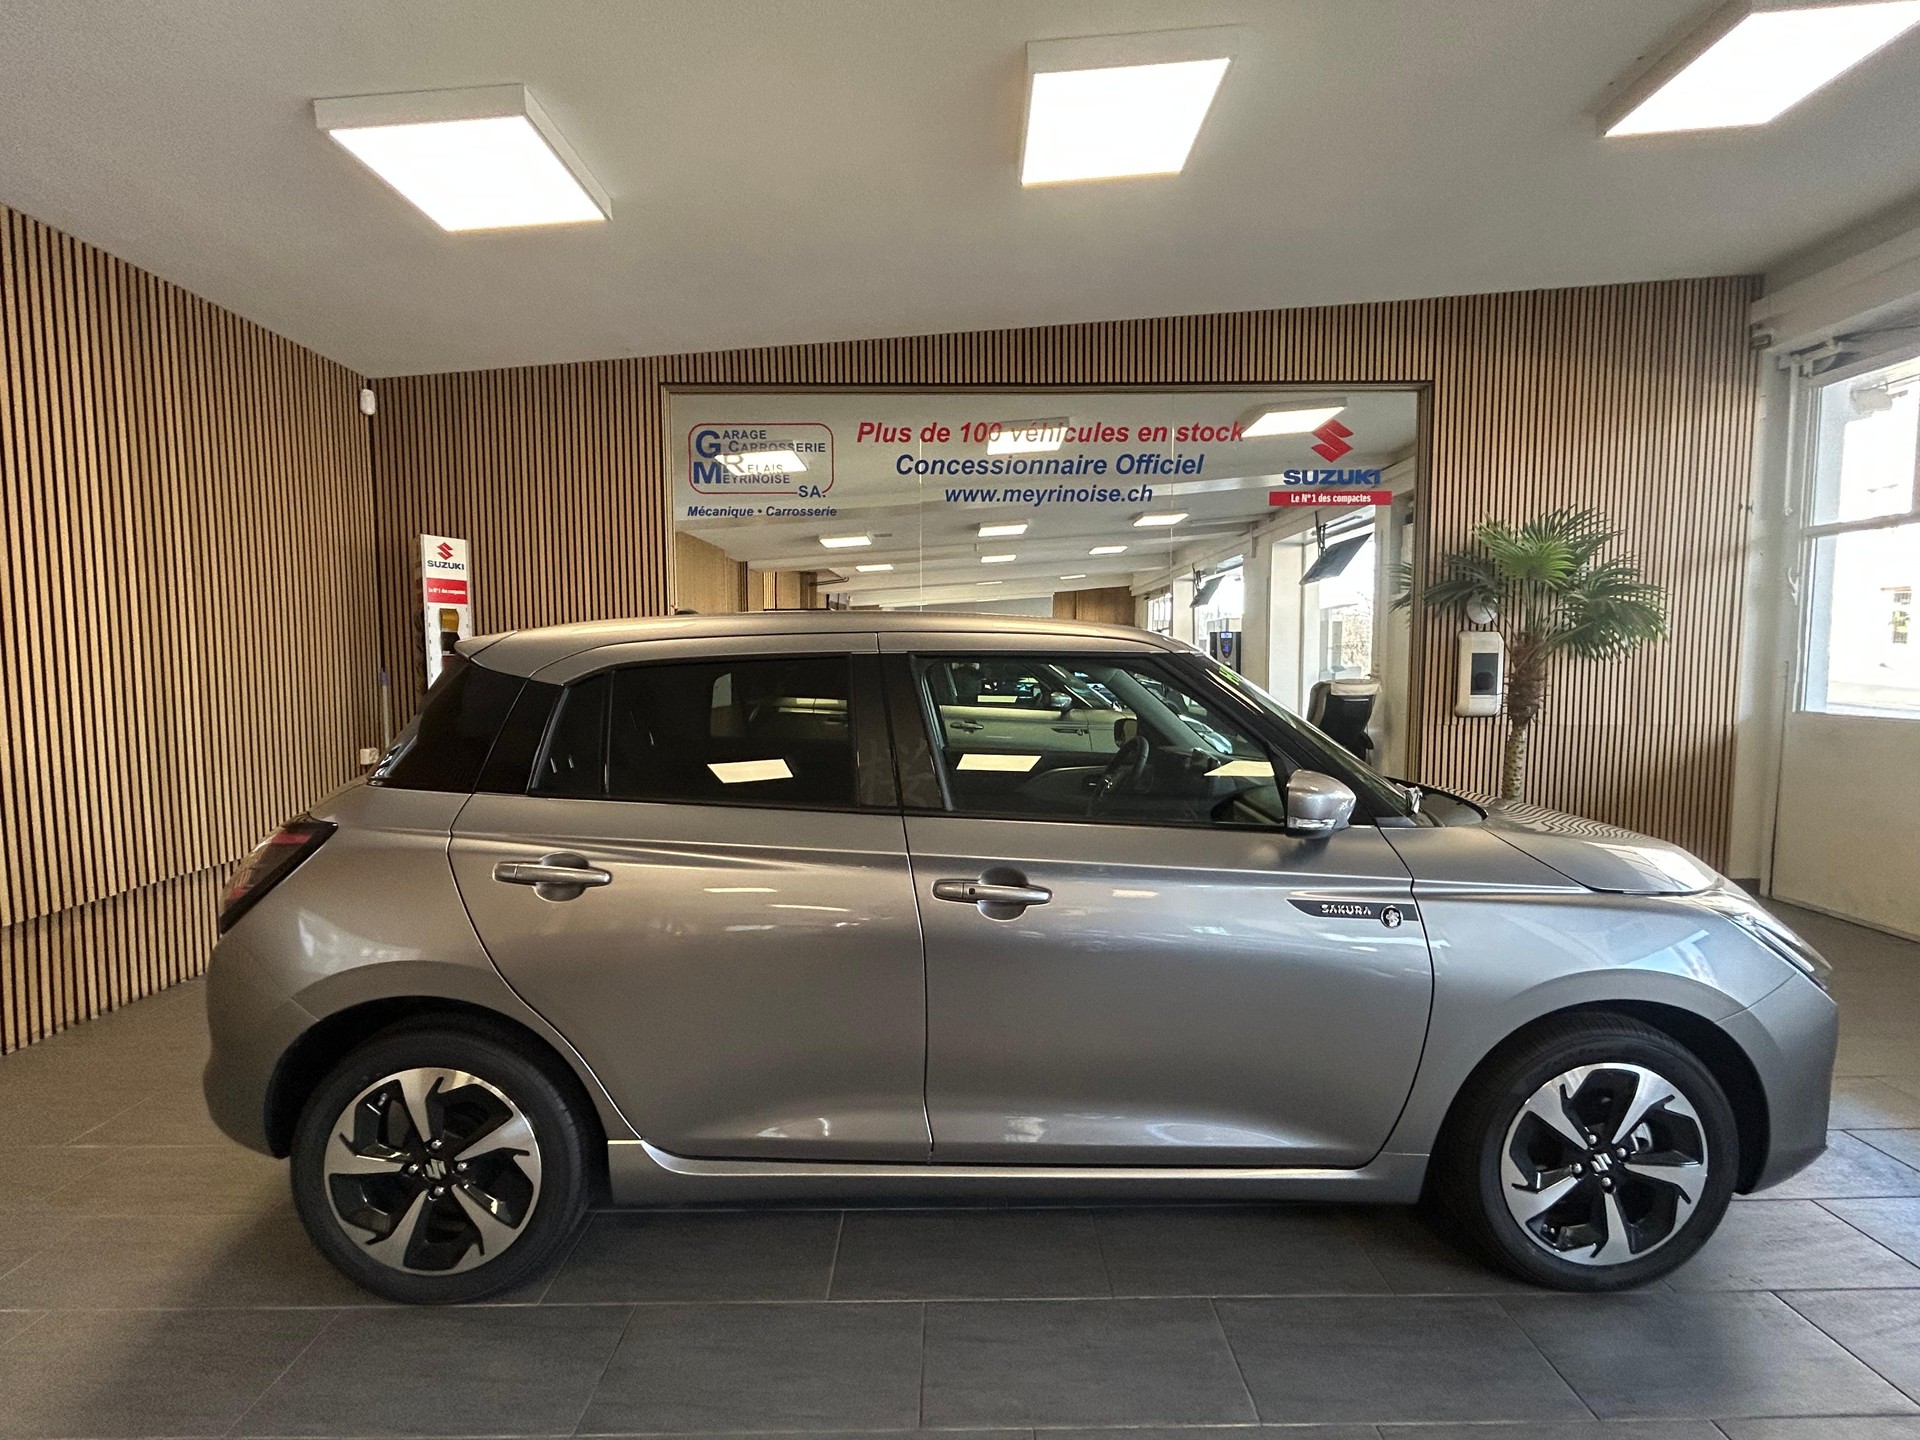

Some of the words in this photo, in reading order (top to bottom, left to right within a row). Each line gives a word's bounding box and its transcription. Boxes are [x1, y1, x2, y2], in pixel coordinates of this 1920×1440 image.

[857, 422, 912, 443] Plus
[920, 422, 950, 443] de
[960, 422, 1003, 443] 100
[1011, 421, 1130, 443] véhicules
[1138, 426, 1168, 443] en
[1175, 422, 1244, 443] stock
[695, 430, 767, 459] GARAGE
[728, 440, 826, 453] CARROSSERIE
[693, 461, 791, 484] MEYRINOISE
[722, 452, 784, 474] RELAIS
[896, 454, 1107, 475] Concessionnaire
[1116, 454, 1205, 475] Officiel
[1283, 469, 1381, 486] SUZUKI
[945, 485, 1153, 507] www.meyrinoise.ch
[1290, 494, 1300, 503] Le
[1318, 493, 1331, 503] des
[1332, 493, 1372, 504] compactes
[687, 505, 754, 518] Mécanique
[766, 505, 838, 516] Carrosserie
[427, 560, 465, 570] SUZUKI
[1321, 904, 1371, 915] SAKURA
